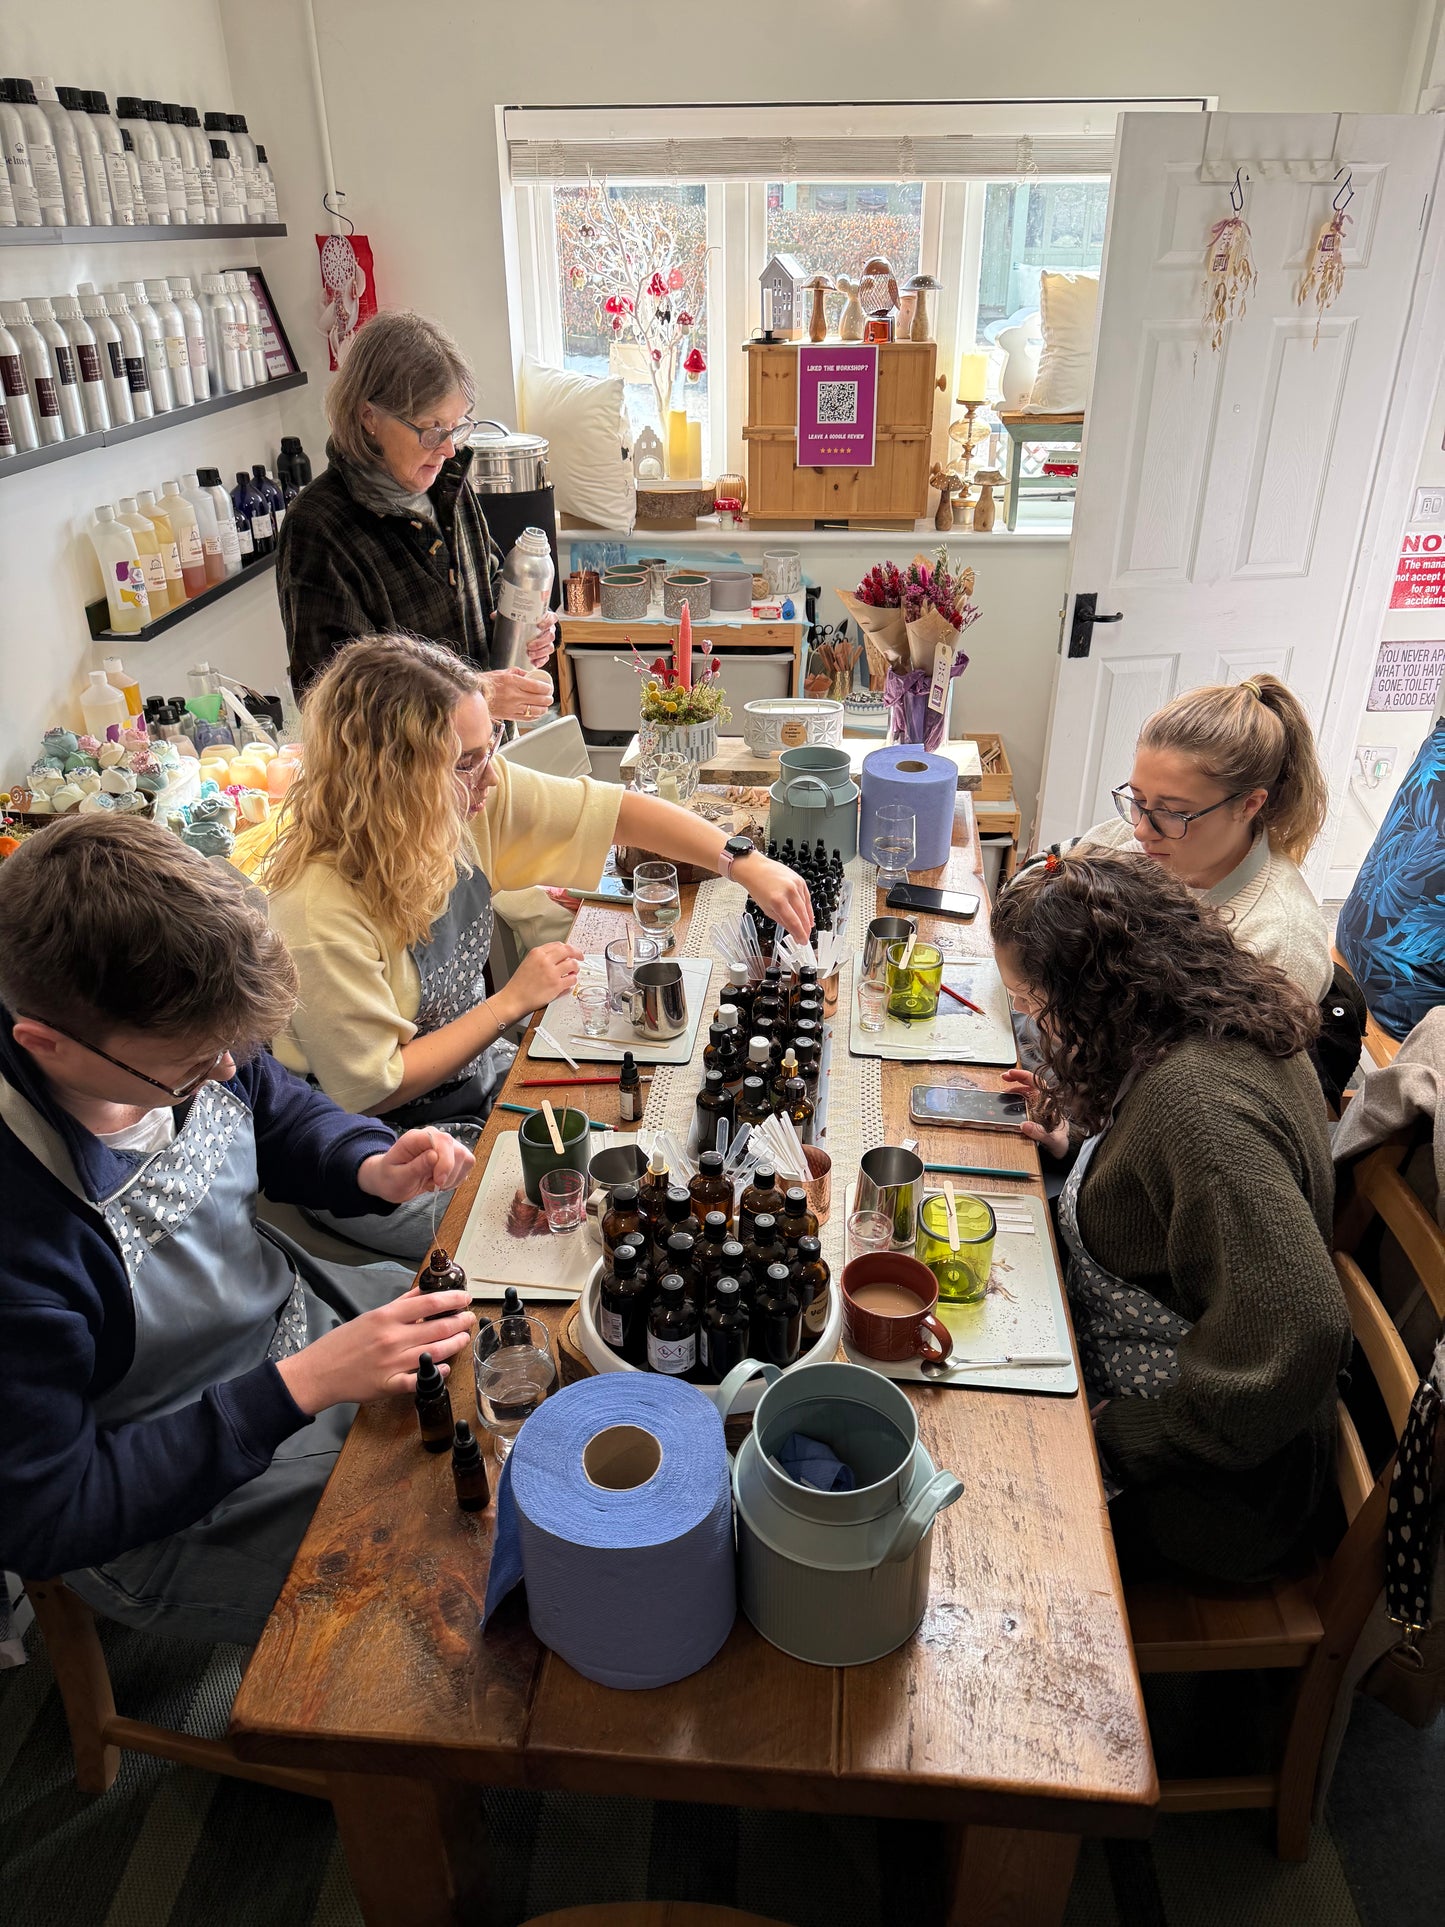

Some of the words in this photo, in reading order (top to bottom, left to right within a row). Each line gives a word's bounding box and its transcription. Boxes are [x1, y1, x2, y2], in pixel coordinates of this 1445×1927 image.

[835, 364, 869, 372] WORKSHOP?
[1401, 534, 1445, 552] NO
[1404, 560, 1421, 570] The
[1395, 573, 1410, 582] not
[1411, 571, 1441, 583] accept
[1411, 584, 1424, 594] for
[1424, 585, 1441, 595] any
[1382, 649, 1400, 663] YOU
[1400, 649, 1430, 662] NEVER
[1375, 664, 1401, 677] WHAT
[1402, 664, 1421, 677] YOU
[1384, 694, 1391, 706] A
[1393, 693, 1418, 706] GOOD
